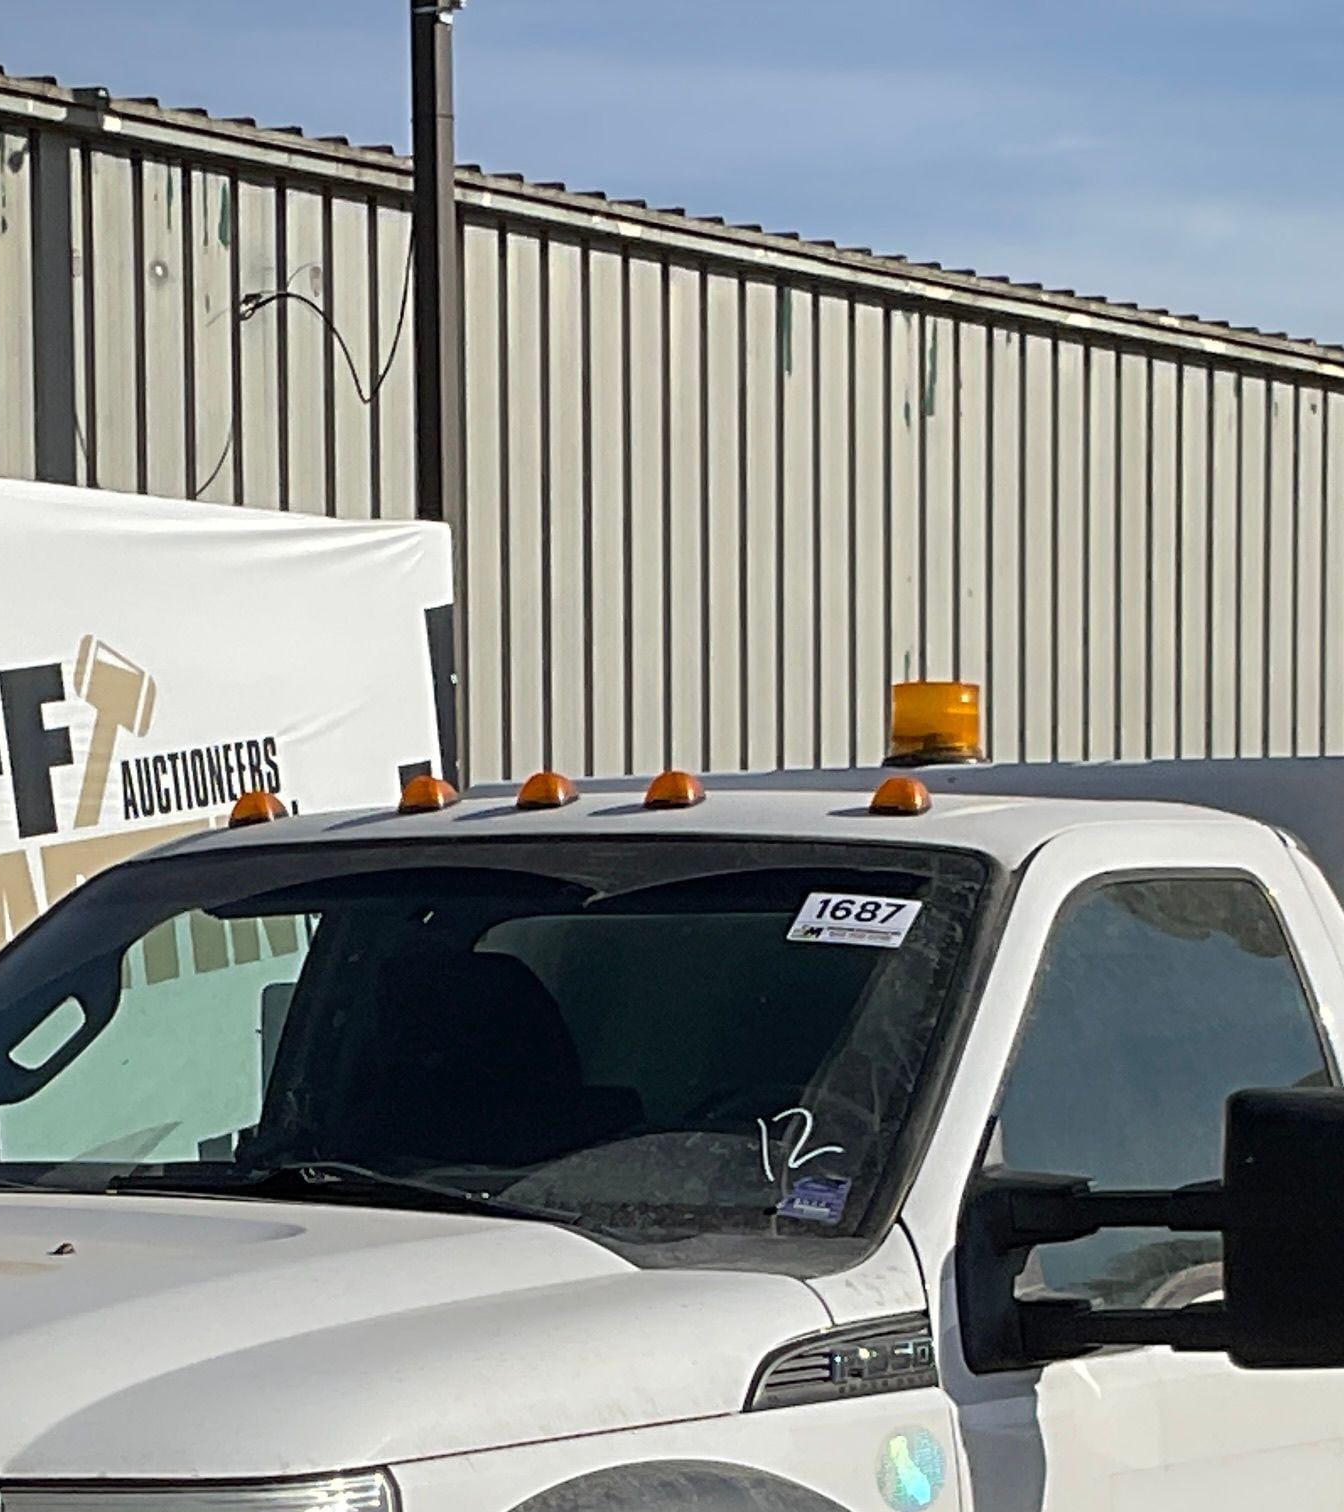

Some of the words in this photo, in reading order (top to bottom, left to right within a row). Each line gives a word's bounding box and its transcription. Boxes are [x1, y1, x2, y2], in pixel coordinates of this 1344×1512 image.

[120, 736, 282, 821] AUCTIONEERS
[816, 898, 908, 924] 1687
[758, 1107, 844, 1182] 12
